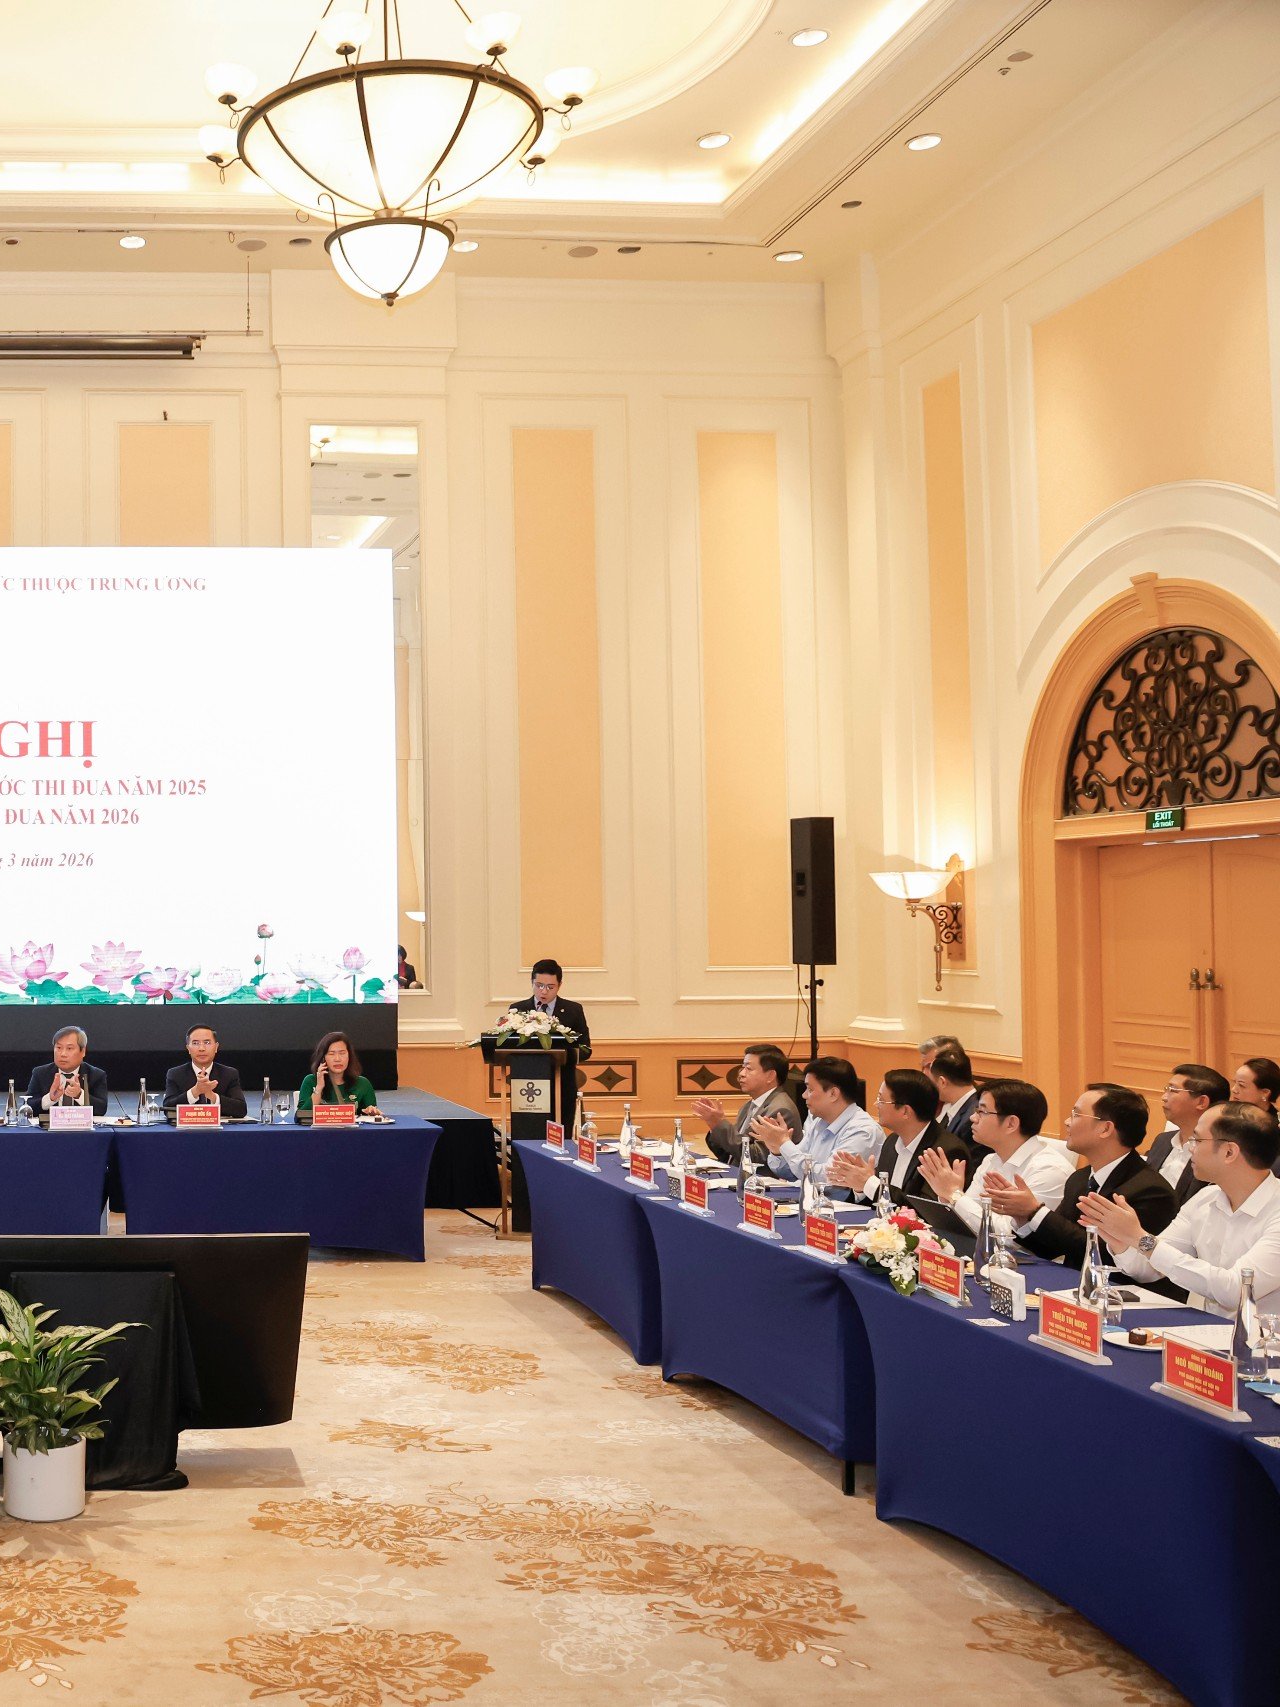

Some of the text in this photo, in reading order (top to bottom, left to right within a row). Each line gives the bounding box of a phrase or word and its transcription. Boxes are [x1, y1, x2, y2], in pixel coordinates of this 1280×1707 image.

[20, 574, 83, 593] THUỘC
[88, 577, 149, 592] TRUNG
[32, 779, 66, 796] THI
[72, 779, 112, 796] ĐUA
[118, 775, 163, 796] NĂM
[168, 778, 207, 796] 2025
[5, 808, 46, 825] ĐUA
[50, 804, 95, 825] NĂM
[101, 808, 140, 825] 2026
[1155, 811, 1173, 821] EXIT
[7, 853, 16, 868] 3
[19, 853, 54, 868] năm
[58, 853, 95, 868] 2026
